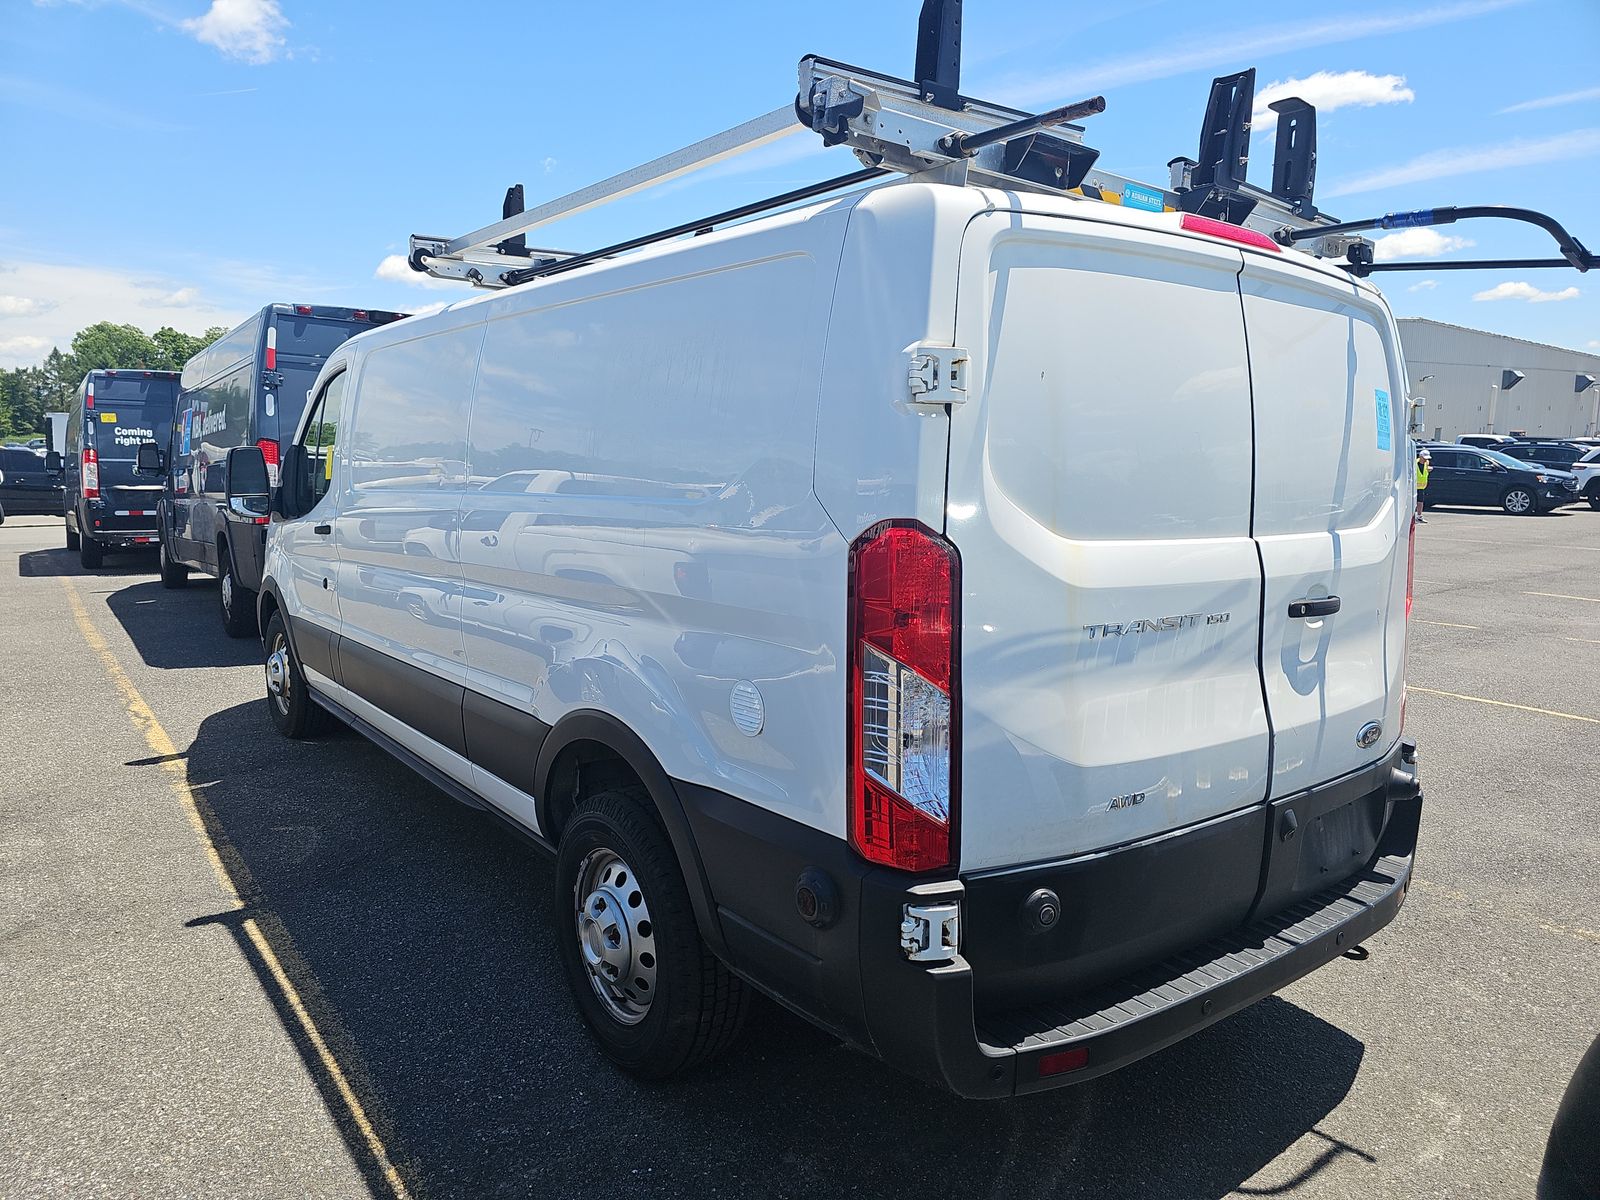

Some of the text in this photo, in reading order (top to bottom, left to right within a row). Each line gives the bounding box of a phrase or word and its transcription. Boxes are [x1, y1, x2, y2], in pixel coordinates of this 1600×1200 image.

[114, 427, 153, 438] Coming
[115, 436, 142, 446] right
[1083, 612, 1231, 639] TRANSIT 150
[1105, 792, 1145, 812] AWD
